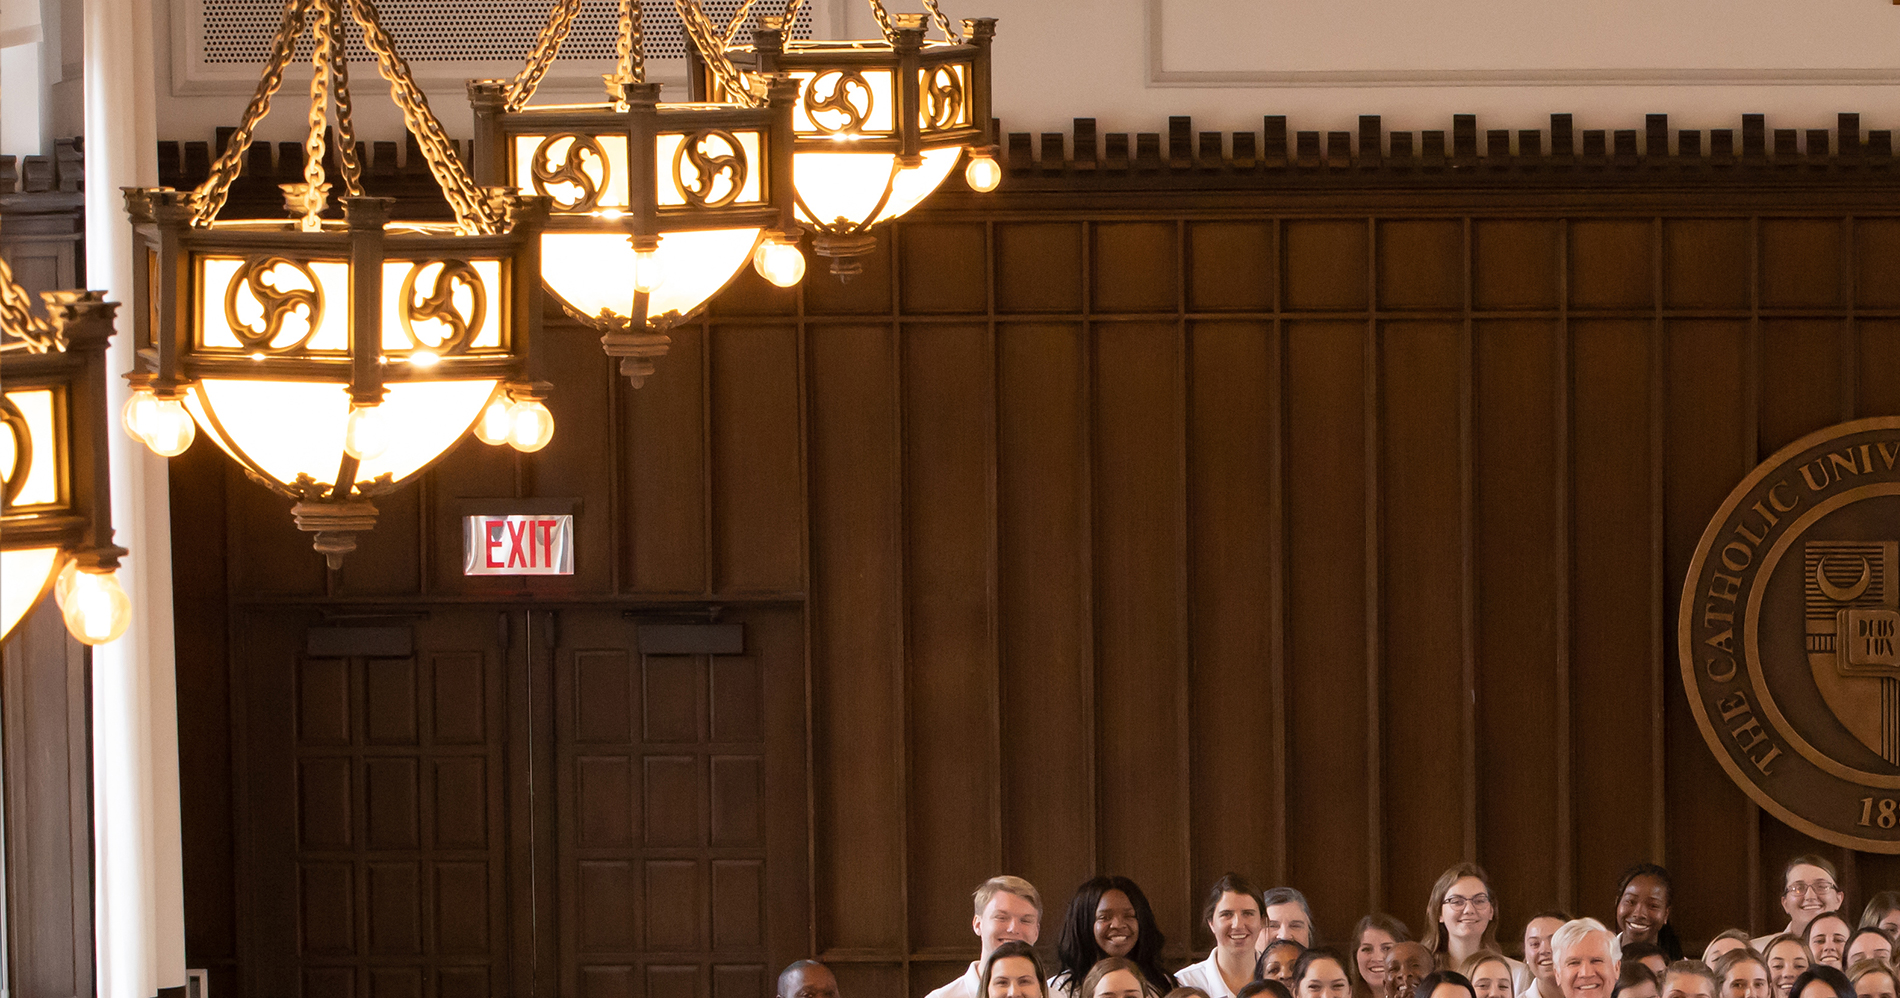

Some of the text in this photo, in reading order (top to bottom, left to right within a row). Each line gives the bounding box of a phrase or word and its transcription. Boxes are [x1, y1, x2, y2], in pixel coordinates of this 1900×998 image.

[485, 520, 557, 569] EXIT
[1704, 480, 1799, 683] CATHOLIC
[1717, 690, 1784, 777] THE
